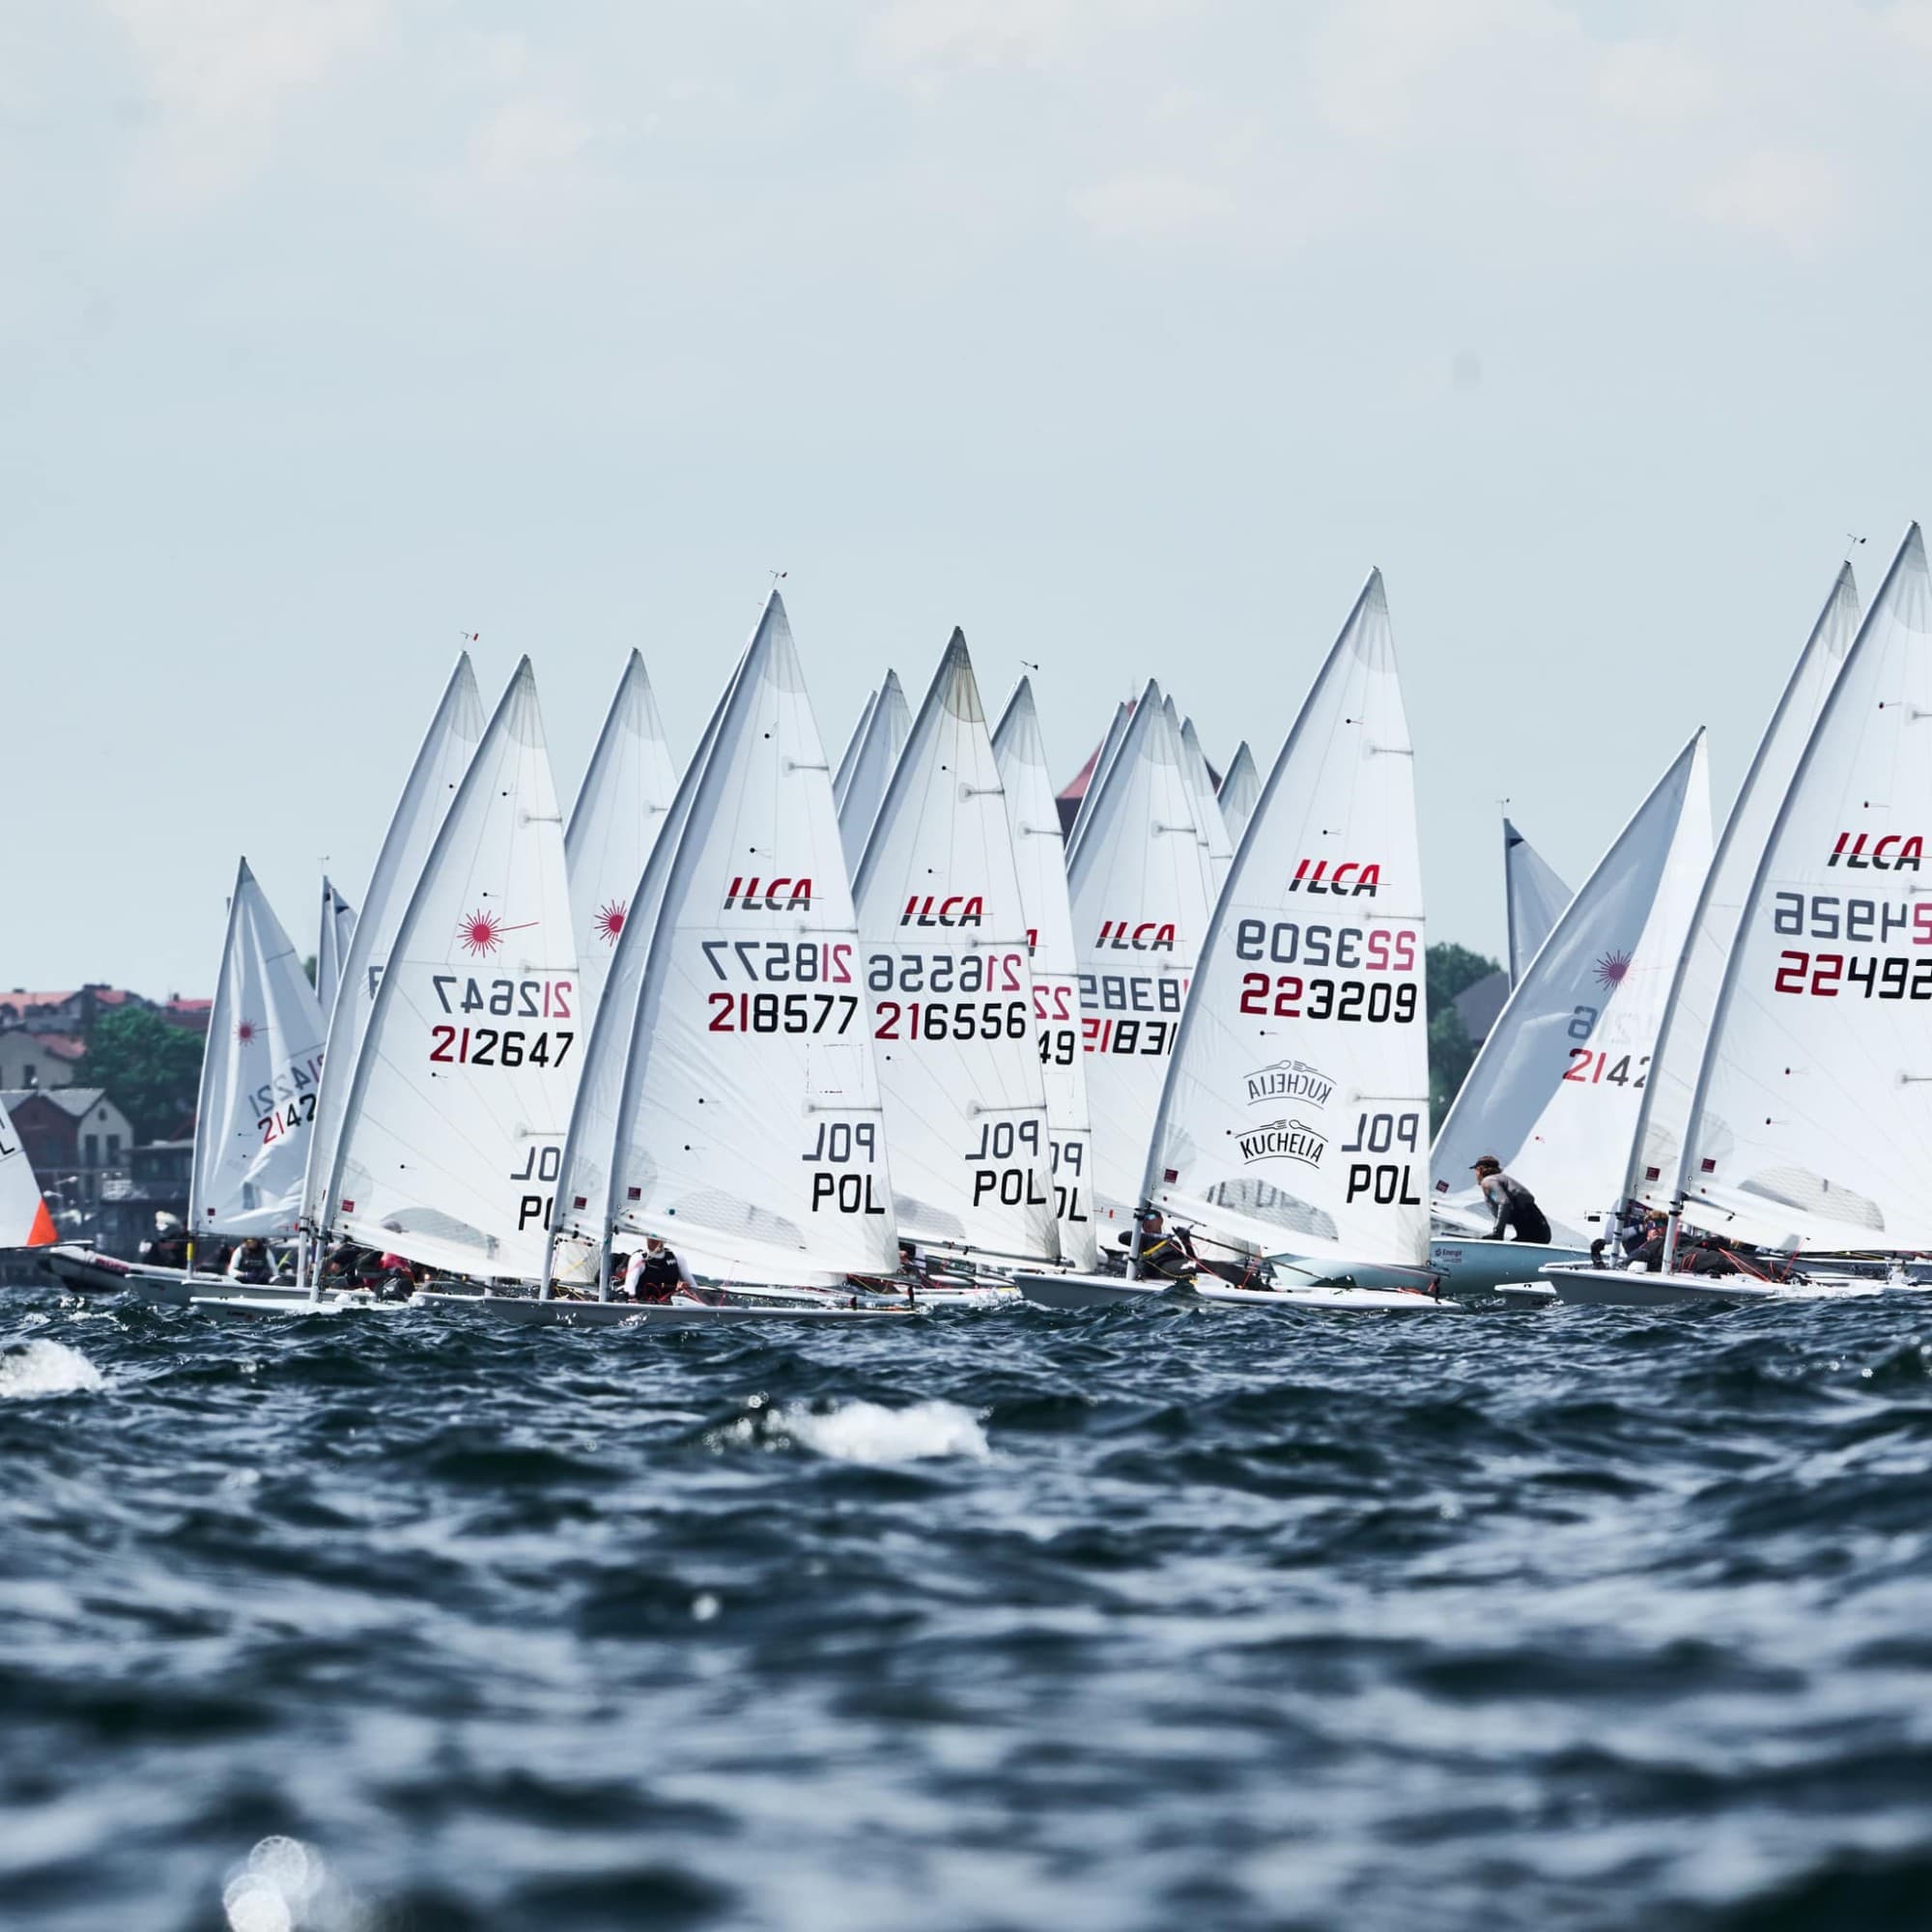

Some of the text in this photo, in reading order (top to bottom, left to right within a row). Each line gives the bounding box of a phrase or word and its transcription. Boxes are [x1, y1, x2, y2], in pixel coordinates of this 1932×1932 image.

[1827, 833, 1923, 871] ILCA
[724, 877, 811, 911] ILCA
[1289, 859, 1380, 897] ILCA
[900, 896, 983, 926] ILCA
[1095, 921, 1175, 952] ILCA
[1775, 951, 1932, 1000] 22492
[708, 993, 858, 1035] 218577
[1239, 973, 1417, 1023] 223209
[874, 1002, 1027, 1040] 216556
[430, 1025, 575, 1067] 212647
[1239, 1132, 1324, 1163] KUCHELIA
[812, 1173, 886, 1215] POL
[974, 1168, 1047, 1207] POL
[1347, 1164, 1421, 1206] POL
